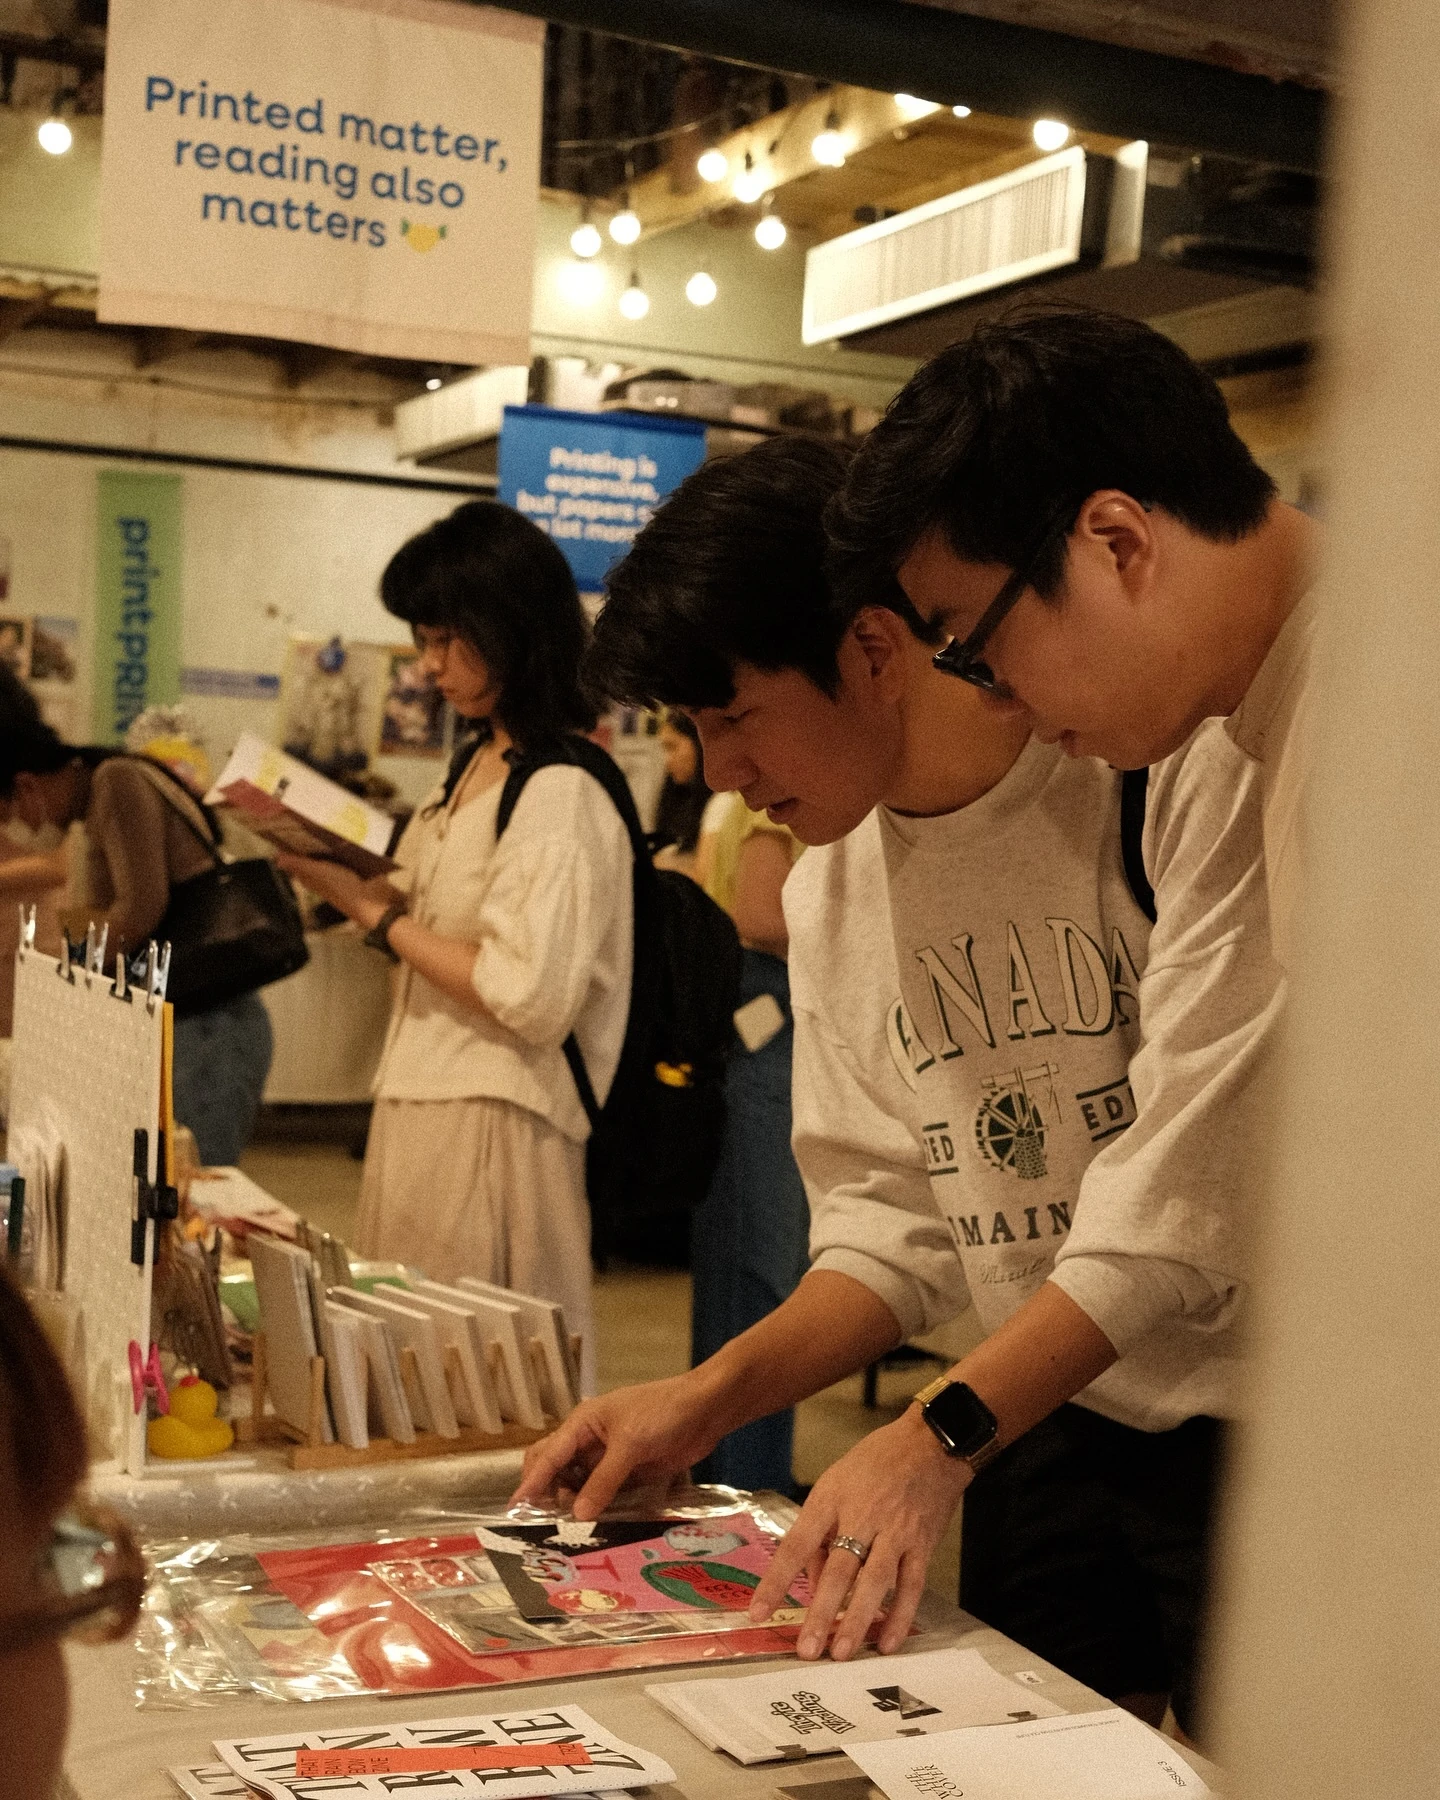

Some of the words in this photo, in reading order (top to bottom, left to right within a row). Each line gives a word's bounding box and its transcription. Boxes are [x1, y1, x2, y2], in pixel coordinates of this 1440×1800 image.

[144, 75, 325, 135] Printed
[338, 110, 509, 173] matter,
[174, 138, 359, 199] reading
[371, 168, 466, 209] also
[202, 192, 387, 249] matters
[550, 447, 636, 481] Printing
[637, 453, 658, 479] is
[516, 489, 556, 513] but
[947, 1201, 1072, 1248] MAIN
[301, 1757, 319, 1776] THAT
[324, 1757, 341, 1775] RAIN
[348, 1757, 366, 1775] BOW
[370, 1756, 390, 1774] ZINE
[1158, 1760, 1168, 1768] 3
[905, 1774, 928, 1795] THE
[911, 1765, 950, 1800] WHITE
[925, 1764, 964, 1798] COVER
[1162, 1767, 1187, 1787] ISSUE
